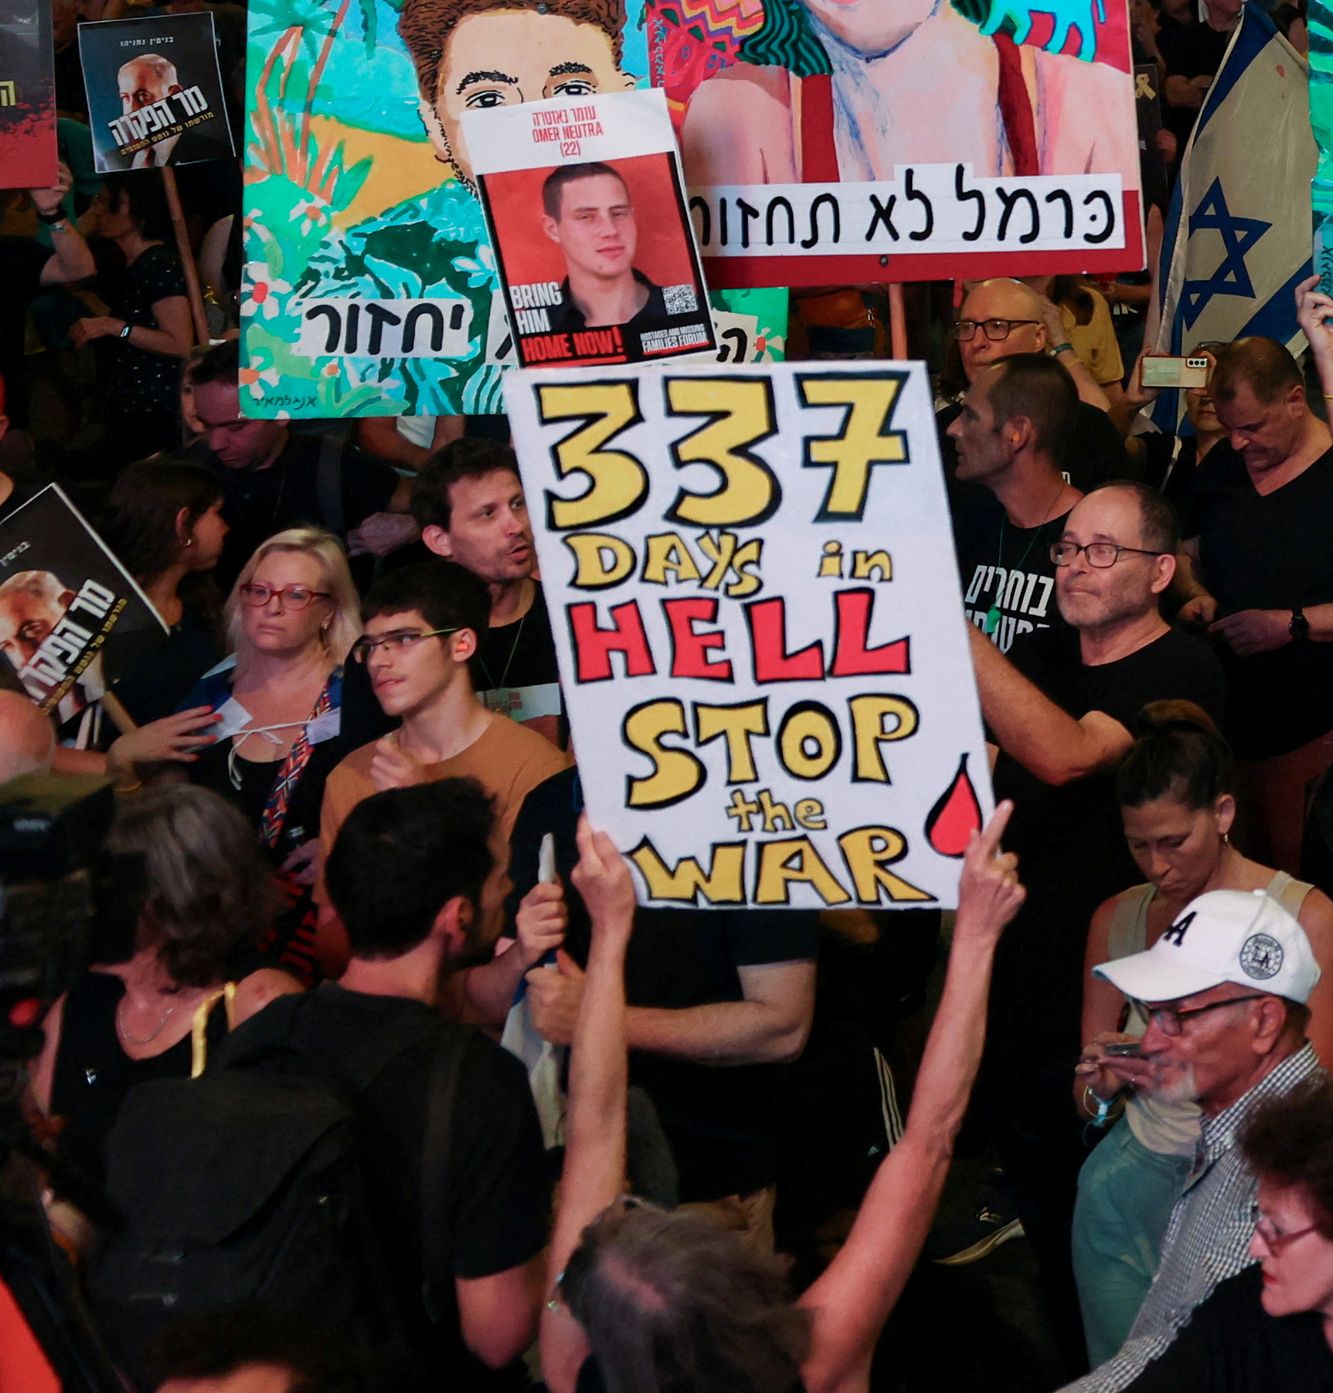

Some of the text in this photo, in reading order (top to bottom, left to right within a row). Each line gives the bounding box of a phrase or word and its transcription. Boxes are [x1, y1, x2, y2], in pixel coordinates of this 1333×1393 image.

[107, 85, 209, 147] מר הפקרה
[532, 121, 604, 143] OMER NEUTRA
[574, 105, 597, 121] עומר
[560, 140, 582, 158] (22)
[689, 164, 1116, 249] כרמל לא תחזור
[509, 281, 563, 309] BRING
[306, 301, 467, 355] יחזור
[514, 308, 552, 335] HIM
[641, 334, 678, 353] FAMILIES
[678, 330, 709, 347] FORUM
[521, 333, 571, 362] HOME
[572, 326, 624, 356] NOW!
[533, 371, 911, 531] 337
[816, 540, 894, 584] in
[70, 579, 116, 619] מר
[964, 565, 1055, 618] בוחרים
[565, 587, 912, 685] HELL
[621, 693, 920, 811] STOP
[726, 789, 828, 833] the
[622, 824, 941, 907] WAR
